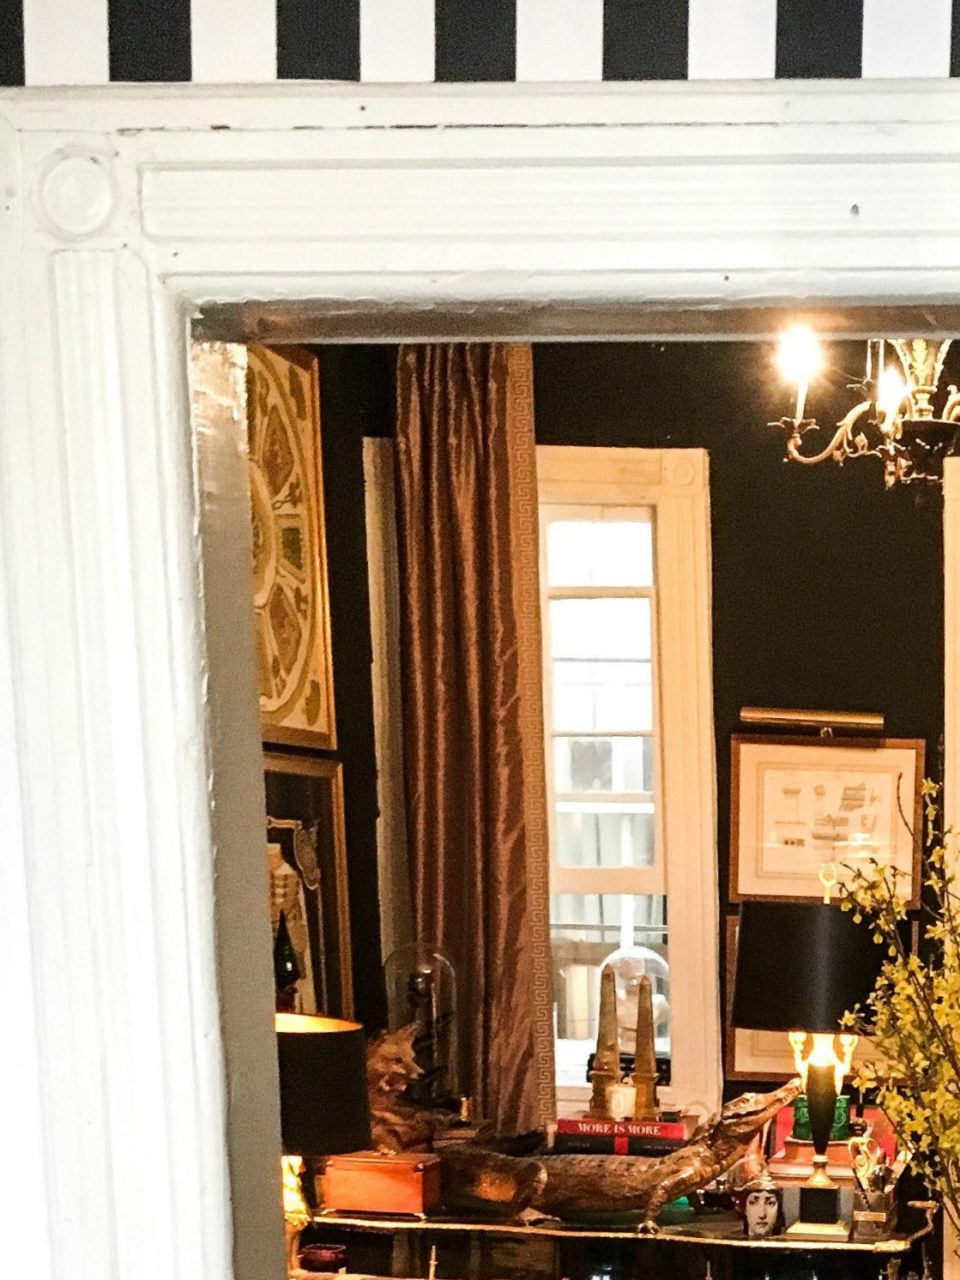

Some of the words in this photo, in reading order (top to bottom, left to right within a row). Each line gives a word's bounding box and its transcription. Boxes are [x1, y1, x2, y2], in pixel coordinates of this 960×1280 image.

[577, 1122, 611, 1134] MORE
[613, 1123, 626, 1134] IS
[627, 1124, 661, 1136] MORE
